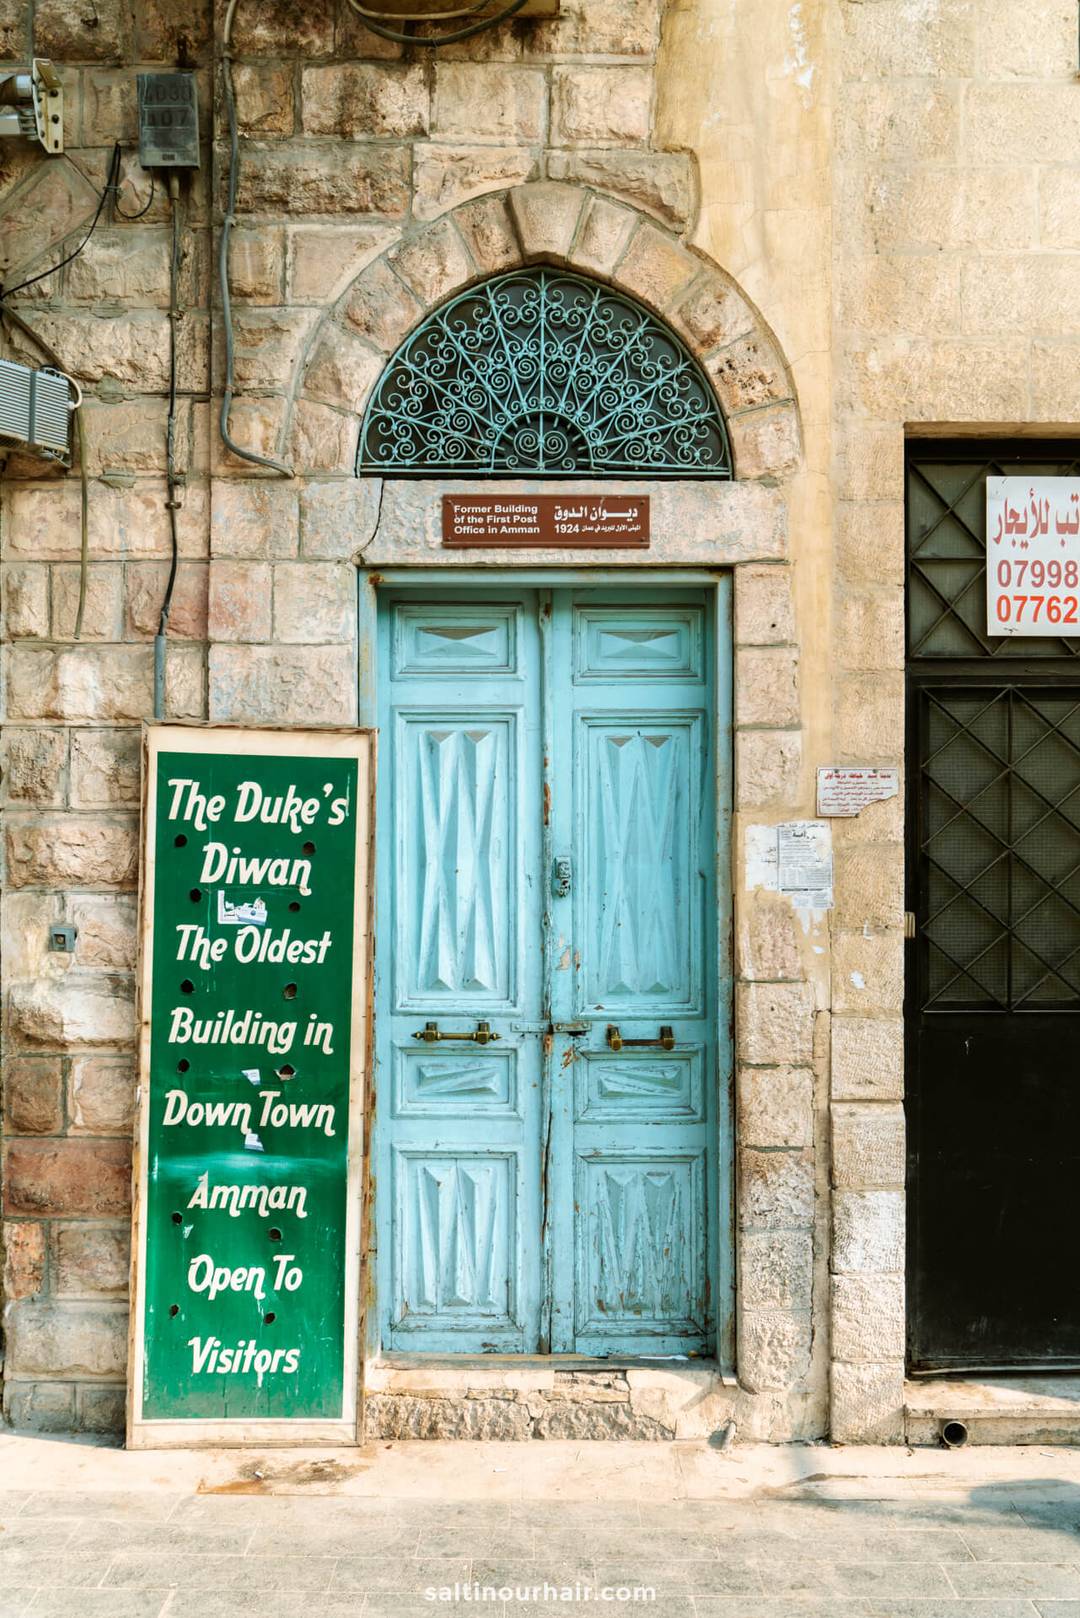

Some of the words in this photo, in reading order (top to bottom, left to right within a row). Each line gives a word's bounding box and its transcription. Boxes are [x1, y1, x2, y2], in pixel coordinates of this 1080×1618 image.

[454, 505, 492, 514] Former
[494, 505, 538, 515] Building
[454, 515, 465, 524] of
[467, 515, 484, 524] the
[486, 515, 511, 524] First
[513, 515, 537, 524] Post
[454, 525, 486, 534] Office
[488, 525, 498, 534] in
[499, 525, 540, 534] Amman
[554, 505, 587, 521] الدوق
[554, 524, 580, 534] 1924
[997, 560, 1079, 588] 07998
[996, 595, 1078, 624] 07762
[168, 778, 226, 832] The
[234, 781, 348, 834] Duke's
[200, 842, 312, 896] Diwan
[175, 924, 228, 970] The
[234, 925, 332, 964] Oldest
[168, 1007, 298, 1055] Building
[304, 1013, 334, 1055] in
[258, 1090, 336, 1137] Town
[187, 1170, 308, 1219] Amman
[187, 1253, 266, 1300] Open
[272, 1254, 303, 1292] To
[187, 1336, 301, 1388] Visitors
